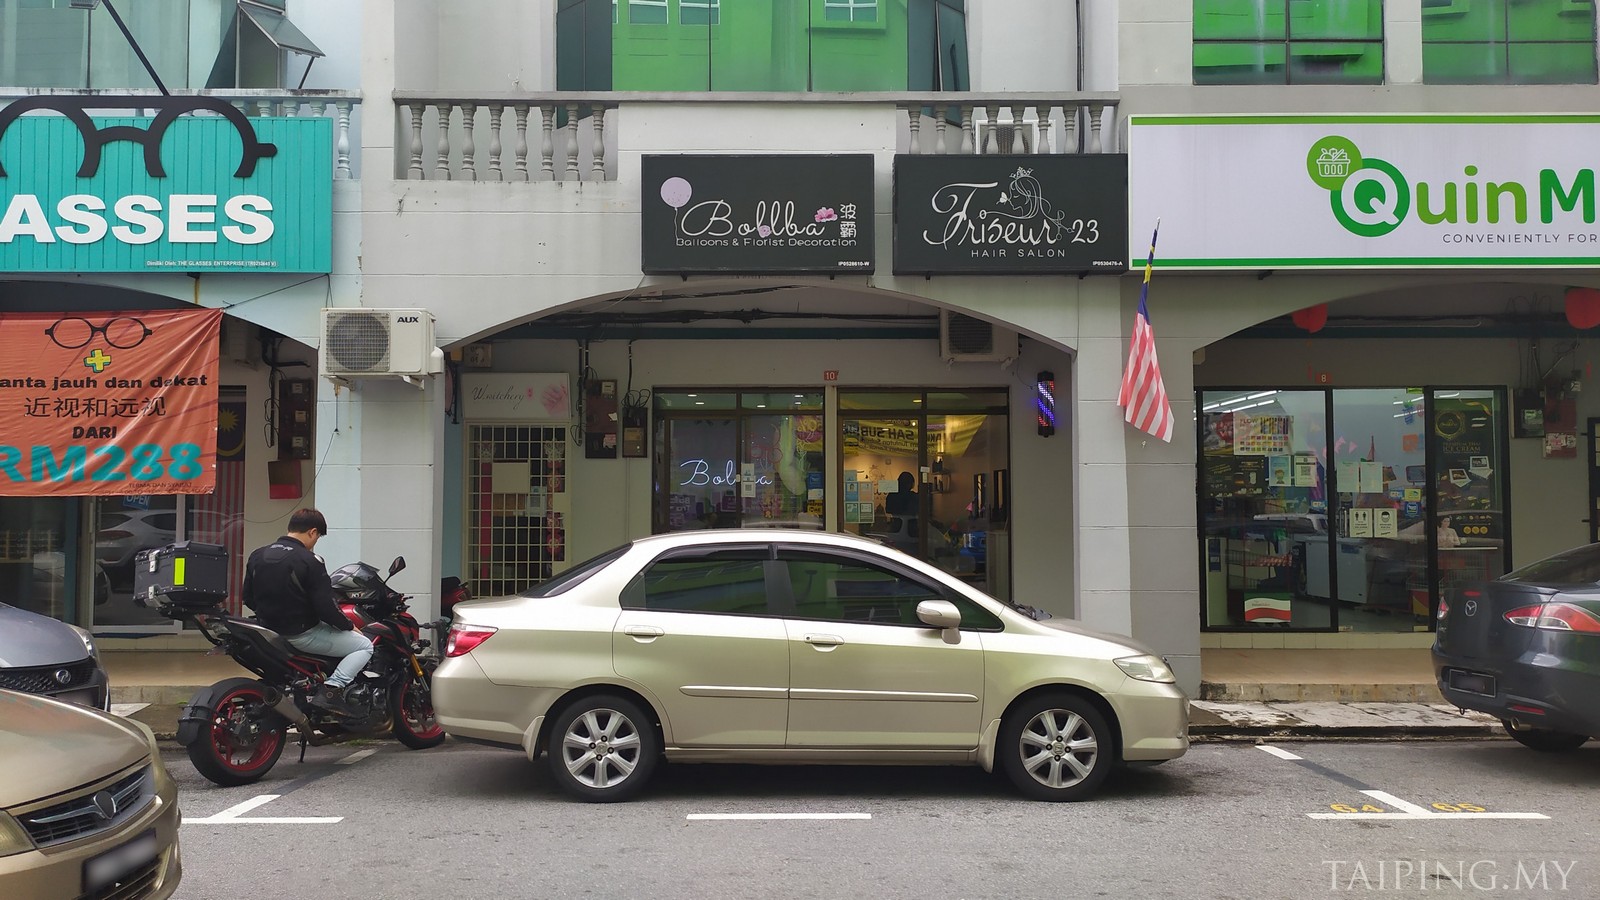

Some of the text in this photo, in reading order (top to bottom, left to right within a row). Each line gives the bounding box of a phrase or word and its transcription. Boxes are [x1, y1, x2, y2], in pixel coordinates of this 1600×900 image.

[0, 194, 275, 245] ASSES
[1071, 219, 1100, 244] 23
[676, 238, 857, 247] Balloons & Florist Decoration
[1442, 233, 1598, 244] CONVENIENTLY FOR
[971, 249, 1065, 258] HAIR SALON
[825, 371, 835, 380] 10
[1321, 374, 1327, 382] 8
[0, 374, 208, 391] anta jauh dan dekat
[24, 397, 166, 418] 近视和远视
[72, 425, 117, 439] DARI
[0, 442, 204, 483] RM288
[1329, 803, 1385, 813] 64
[1431, 802, 1487, 813] 65
